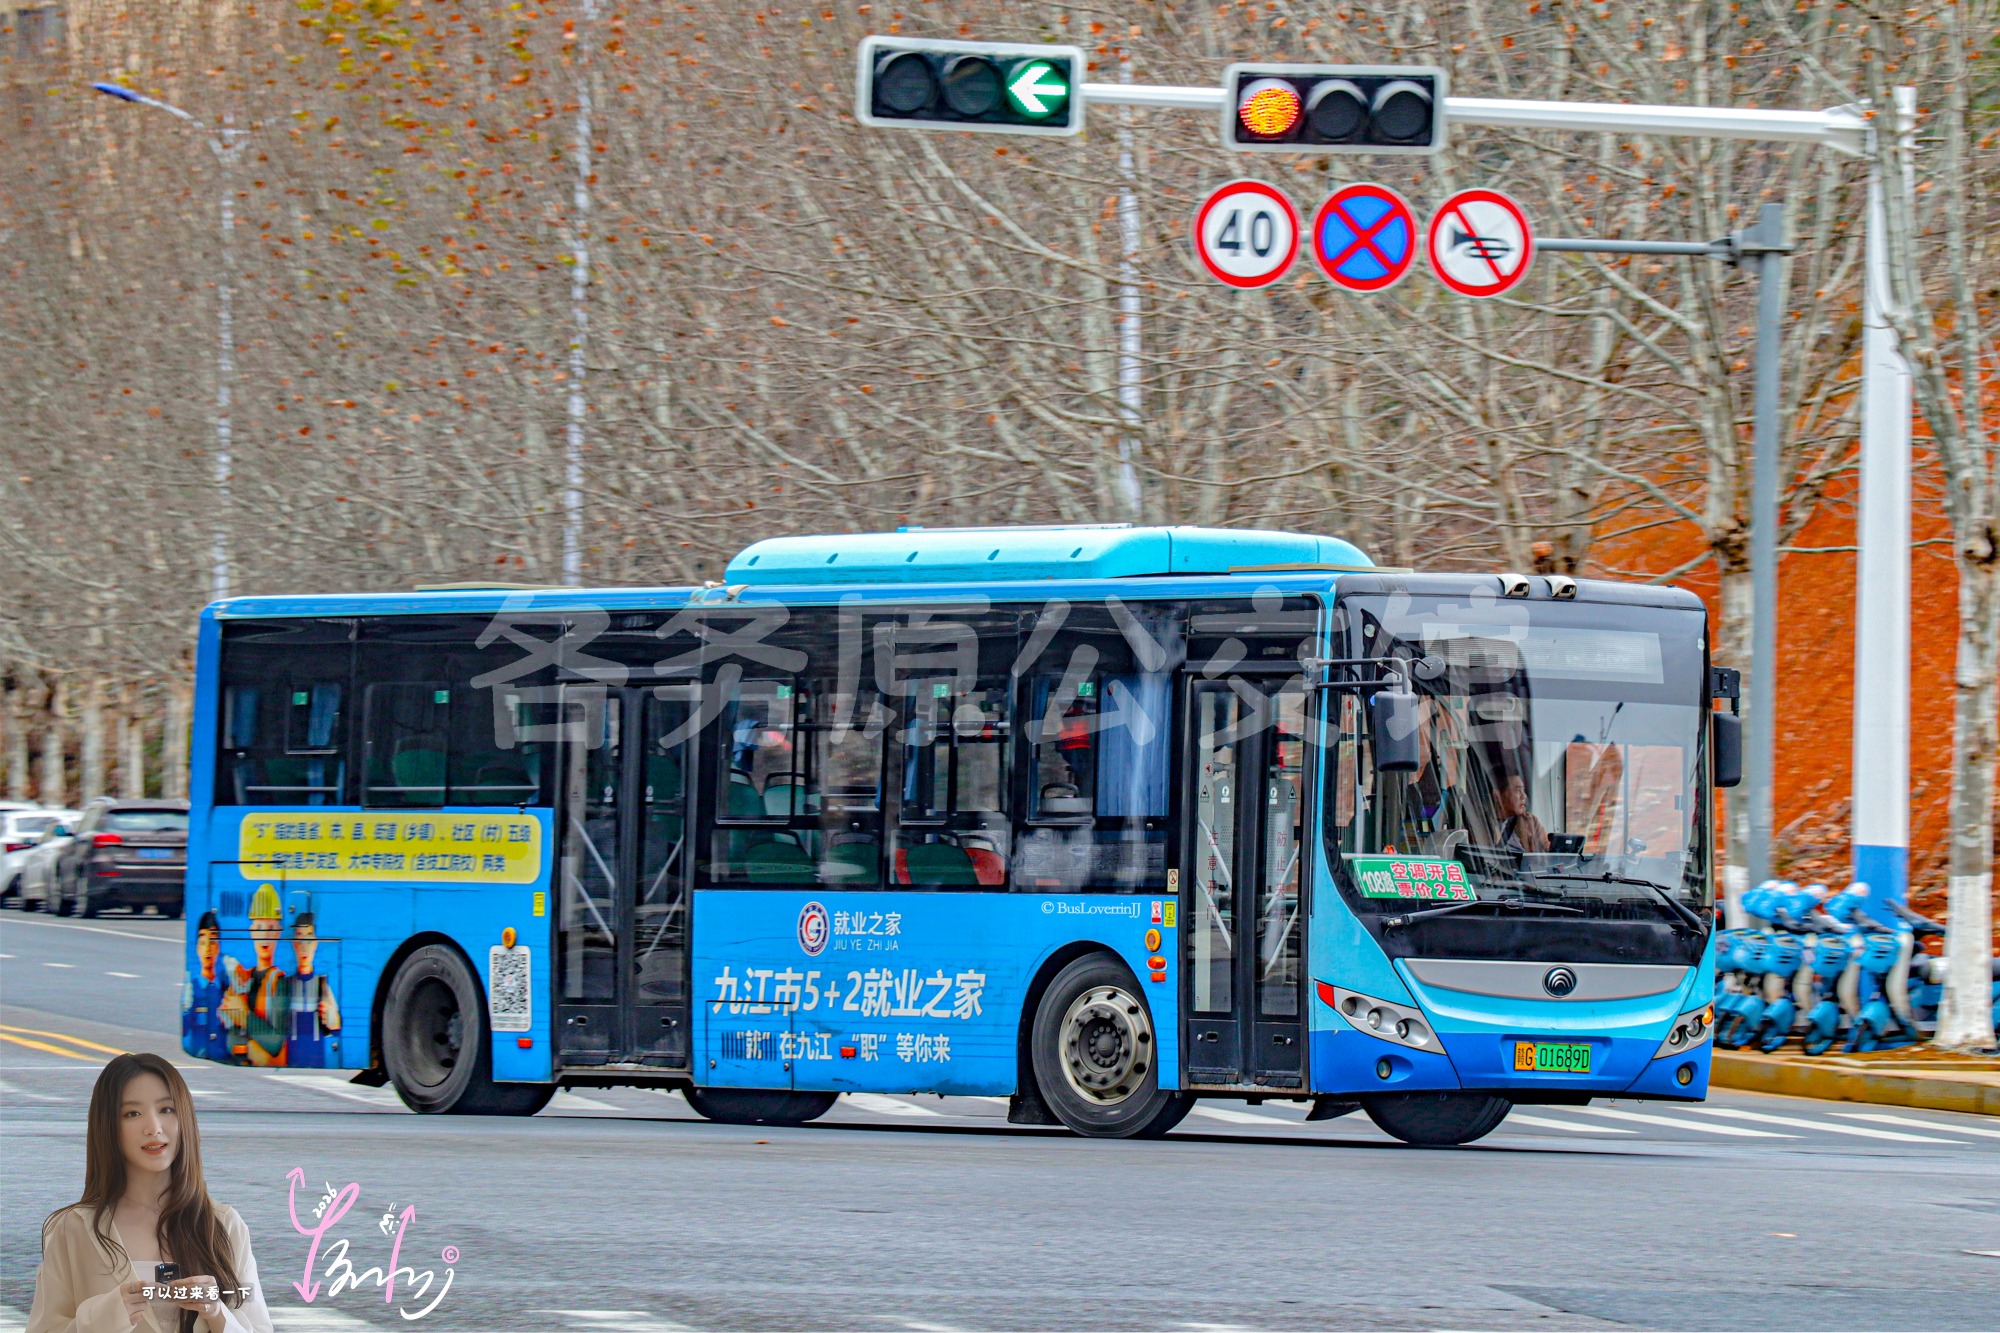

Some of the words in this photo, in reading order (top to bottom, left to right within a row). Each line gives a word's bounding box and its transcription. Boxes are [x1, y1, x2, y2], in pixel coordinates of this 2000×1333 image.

[1218, 209, 1275, 258] 40
[1362, 870, 1396, 893] 108路
[1390, 862, 1463, 882] 空调开启
[1396, 882, 1469, 900] 票价2元
[834, 911, 902, 936] 就业之家
[834, 939, 848, 951] JIU
[850, 939, 862, 951] YE
[867, 939, 882, 951] ZHI
[885, 939, 899, 951] JIA
[712, 966, 987, 1020] 九江市5+2就业之家
